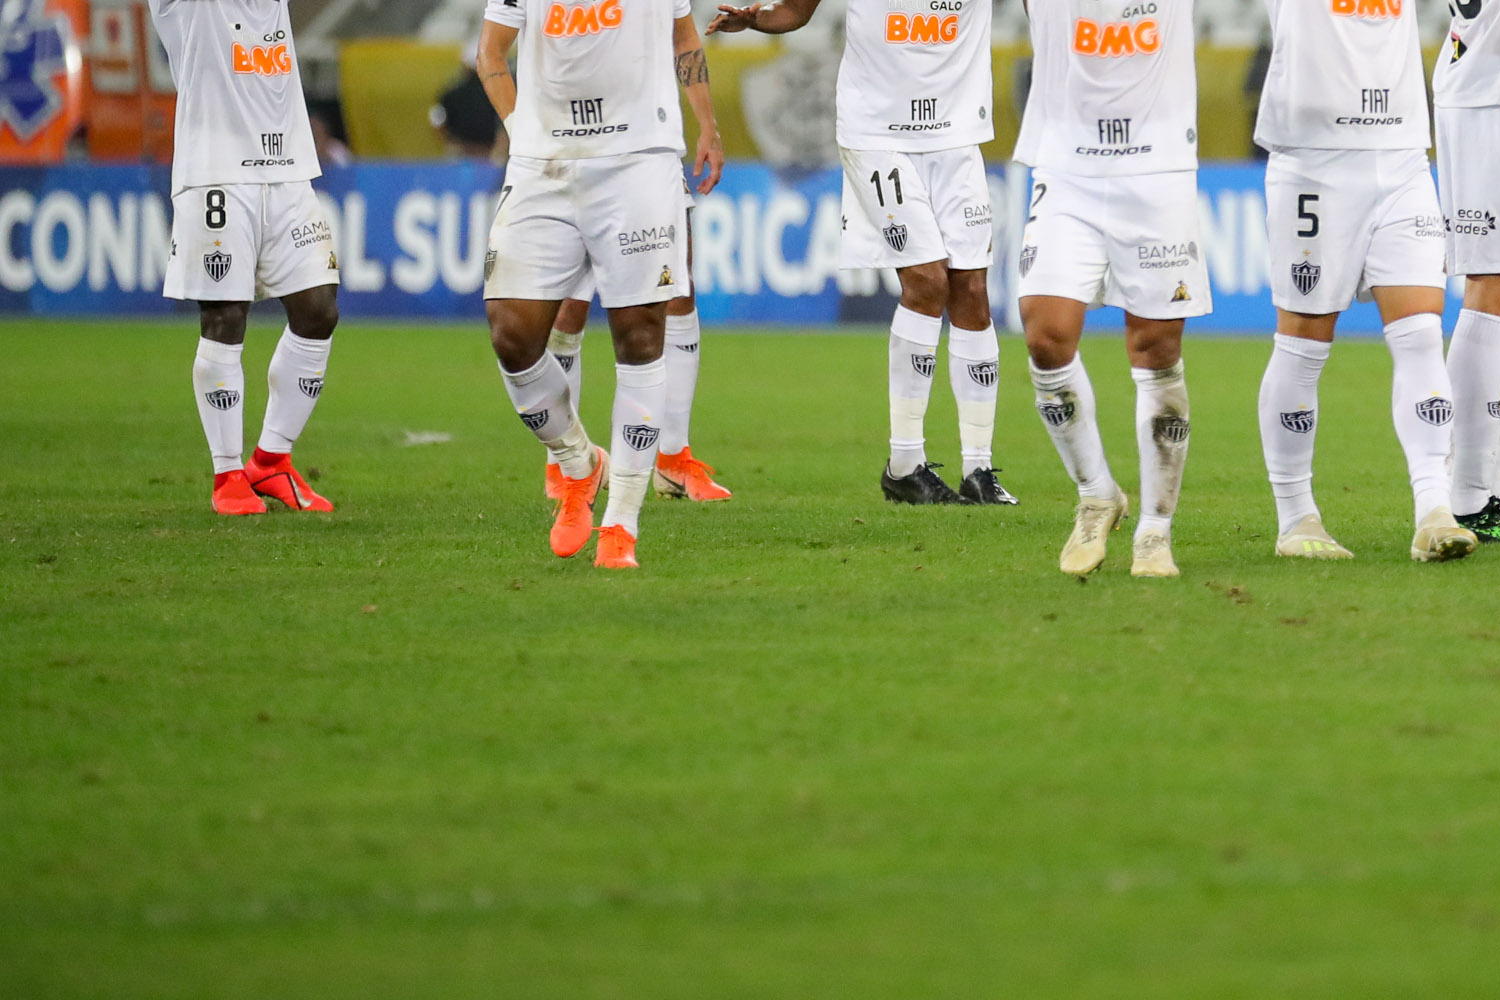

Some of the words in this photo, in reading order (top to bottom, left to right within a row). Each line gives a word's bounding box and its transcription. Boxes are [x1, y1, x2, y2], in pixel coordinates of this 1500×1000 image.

[930, 1, 963, 11] GALO
[1122, 3, 1158, 18] GALO
[264, 30, 286, 42] GLO
[885, 12, 959, 45] BMG
[1073, 18, 1162, 58] BMG
[911, 99, 938, 121] FIAT
[1361, 89, 1390, 114] FIAT
[570, 98, 603, 125] FIAT
[1335, 116, 1403, 126] CRONOS
[552, 124, 630, 137] CRONOS
[888, 121, 951, 131] CRONOS
[1098, 118, 1132, 145] FIAT
[262, 132, 284, 156] FIAT
[1075, 144, 1153, 157] CRONOS
[241, 158, 295, 167] CRONOS
[870, 167, 903, 207] 11
[206, 189, 227, 230] 8
[1297, 194, 1320, 238] 5
[1457, 208, 1483, 219] eco
[618, 226, 668, 247] BAMA
[1138, 244, 1189, 261] BAMA
[1294, 265, 1318, 276] CAM
